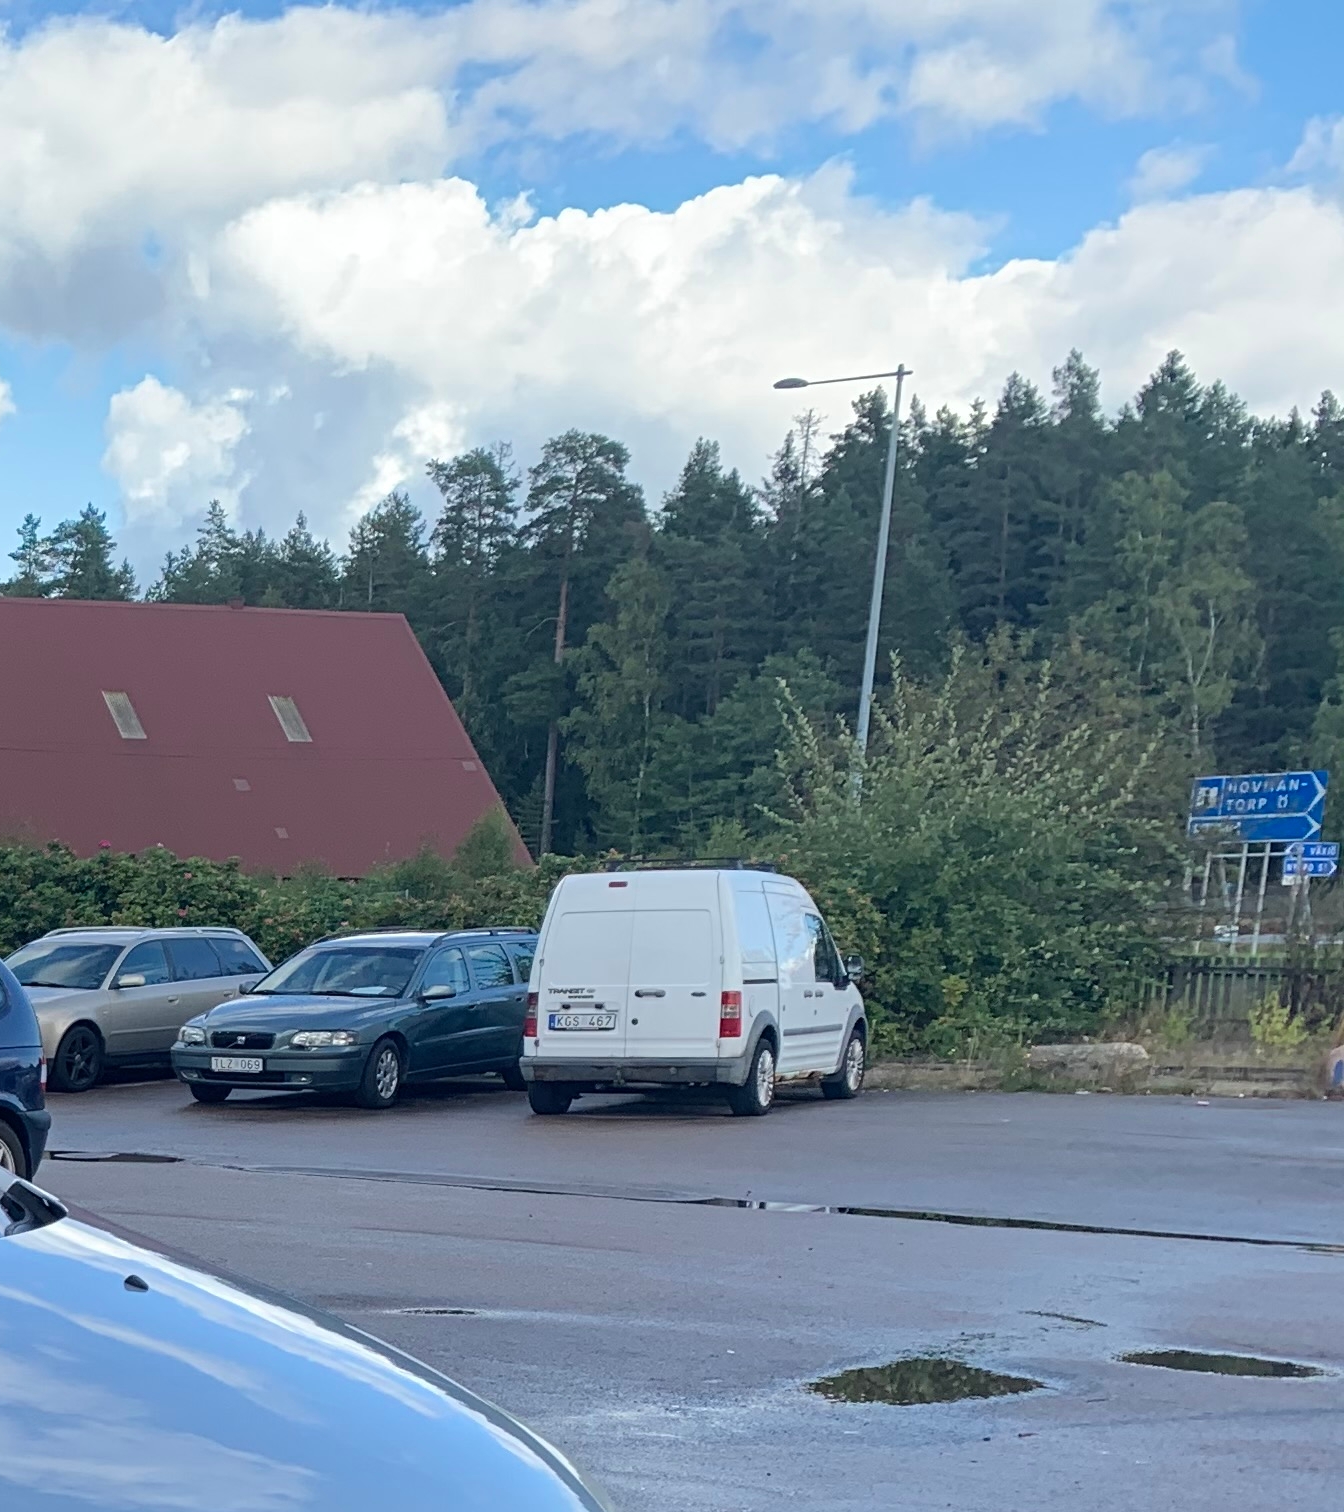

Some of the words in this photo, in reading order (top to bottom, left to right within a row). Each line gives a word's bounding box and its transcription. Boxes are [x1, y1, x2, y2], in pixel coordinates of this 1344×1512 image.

[1226, 797, 1267, 811] TORP
[547, 987, 585, 995] TRANSIT
[556, 1015, 580, 1027] KGS
[588, 1015, 613, 1027] 467
[214, 1058, 233, 1069] TLZ
[240, 1059, 261, 1070] 069
